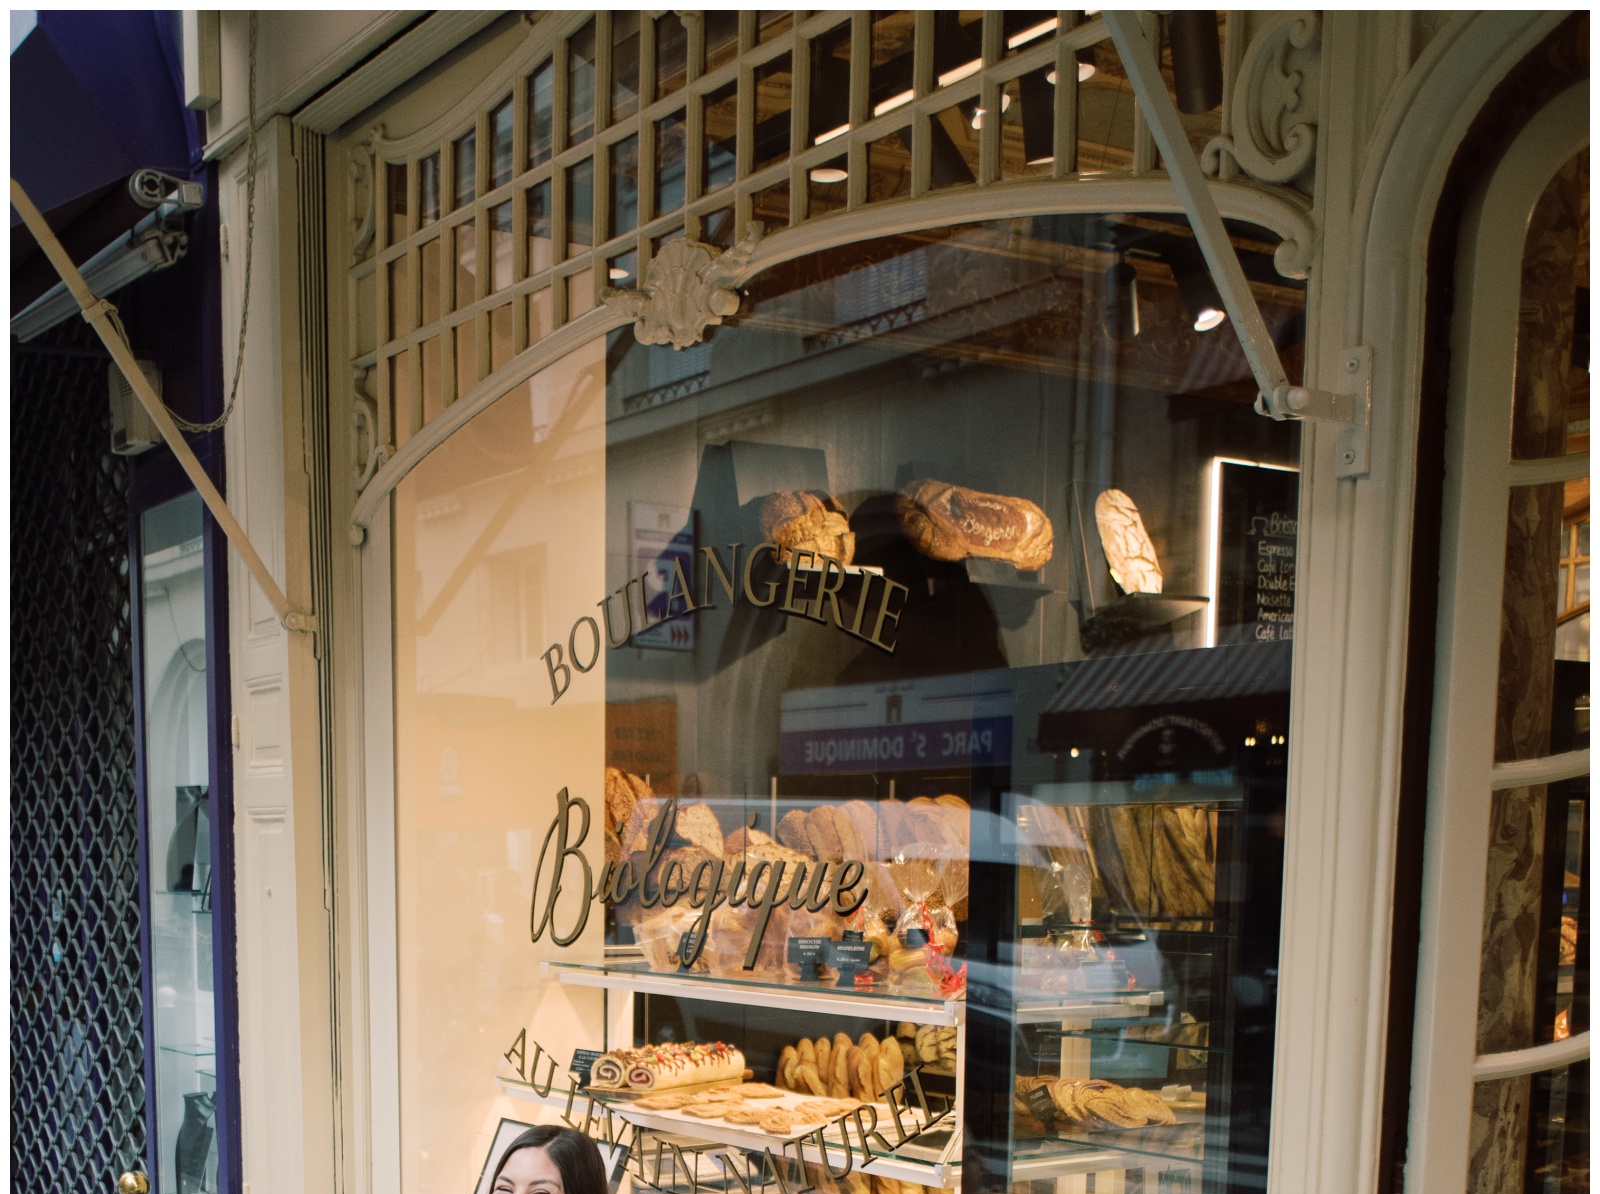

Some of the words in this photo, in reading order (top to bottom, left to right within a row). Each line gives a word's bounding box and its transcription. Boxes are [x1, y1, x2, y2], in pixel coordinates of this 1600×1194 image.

[1258, 541, 1294, 560] Espresso
[1257, 559, 1277, 575] Café
[1258, 575, 1287, 590] Double
[1257, 592, 1292, 607] Noisette
[540, 541, 909, 705] BOULANGERIE
[1255, 624, 1275, 640] Café
[530, 786, 869, 971] Biologique
[504, 1027, 558, 1098] AU
